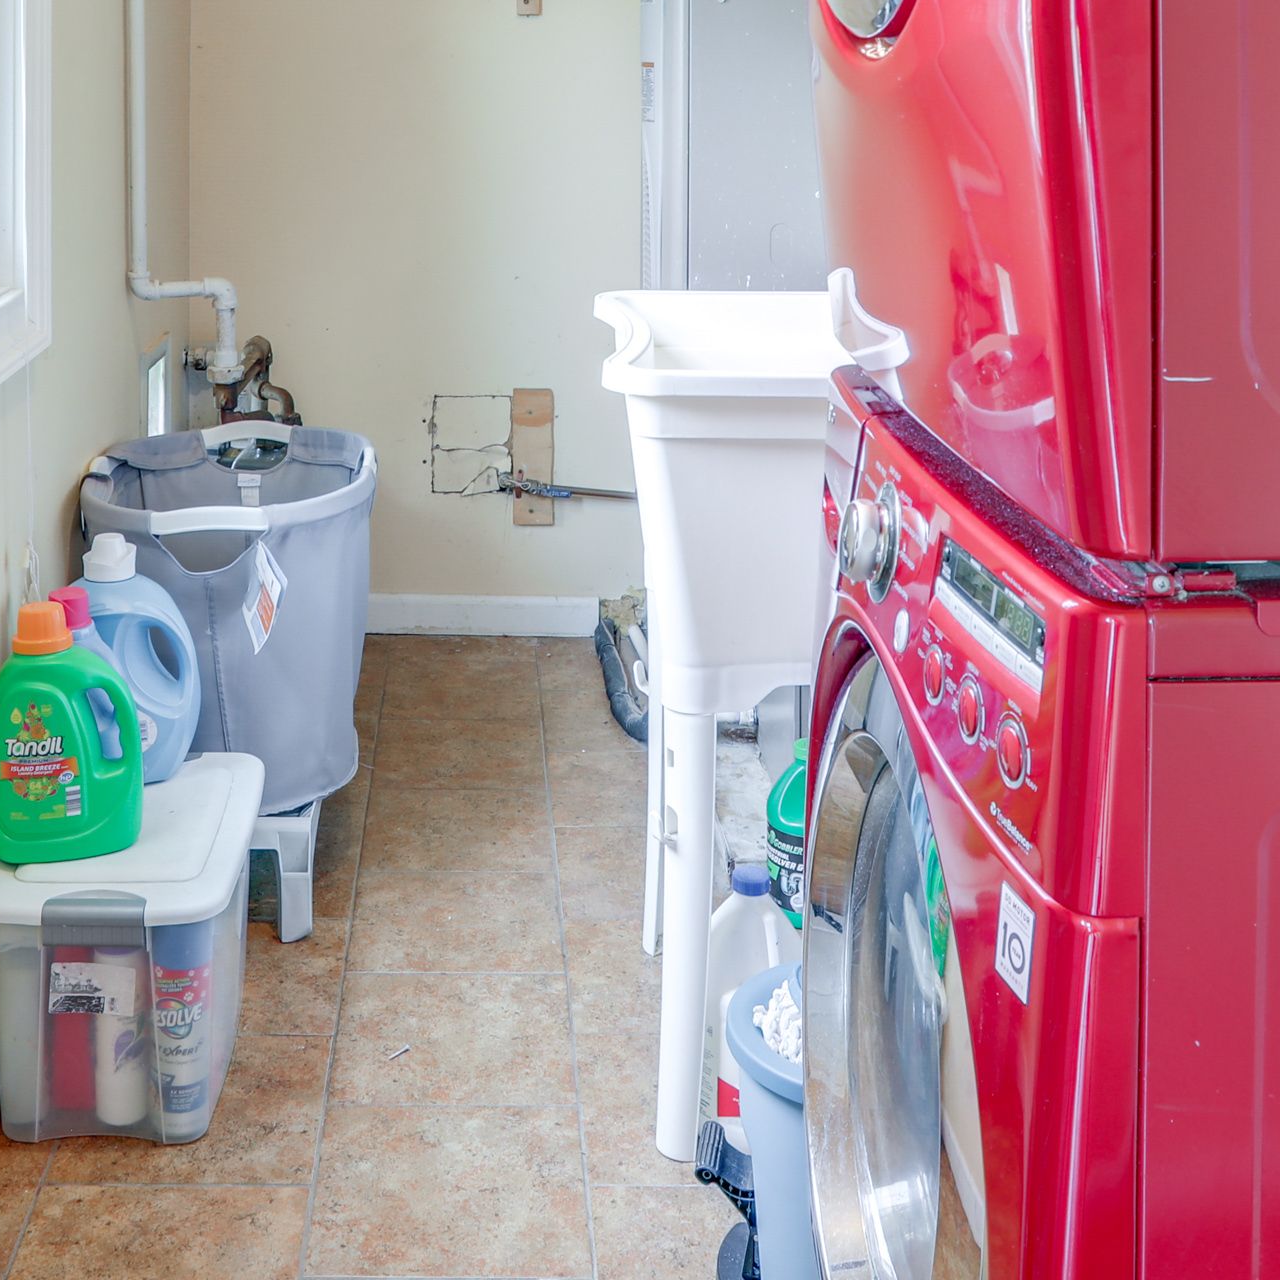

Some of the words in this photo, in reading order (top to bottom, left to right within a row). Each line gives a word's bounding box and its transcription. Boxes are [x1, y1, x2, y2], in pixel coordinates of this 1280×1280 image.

[4, 736, 63, 758] Tandil
[35, 763, 61, 772] BREEZE
[1002, 921, 1026, 975] 10
[156, 1002, 203, 1028] ESOLVE
